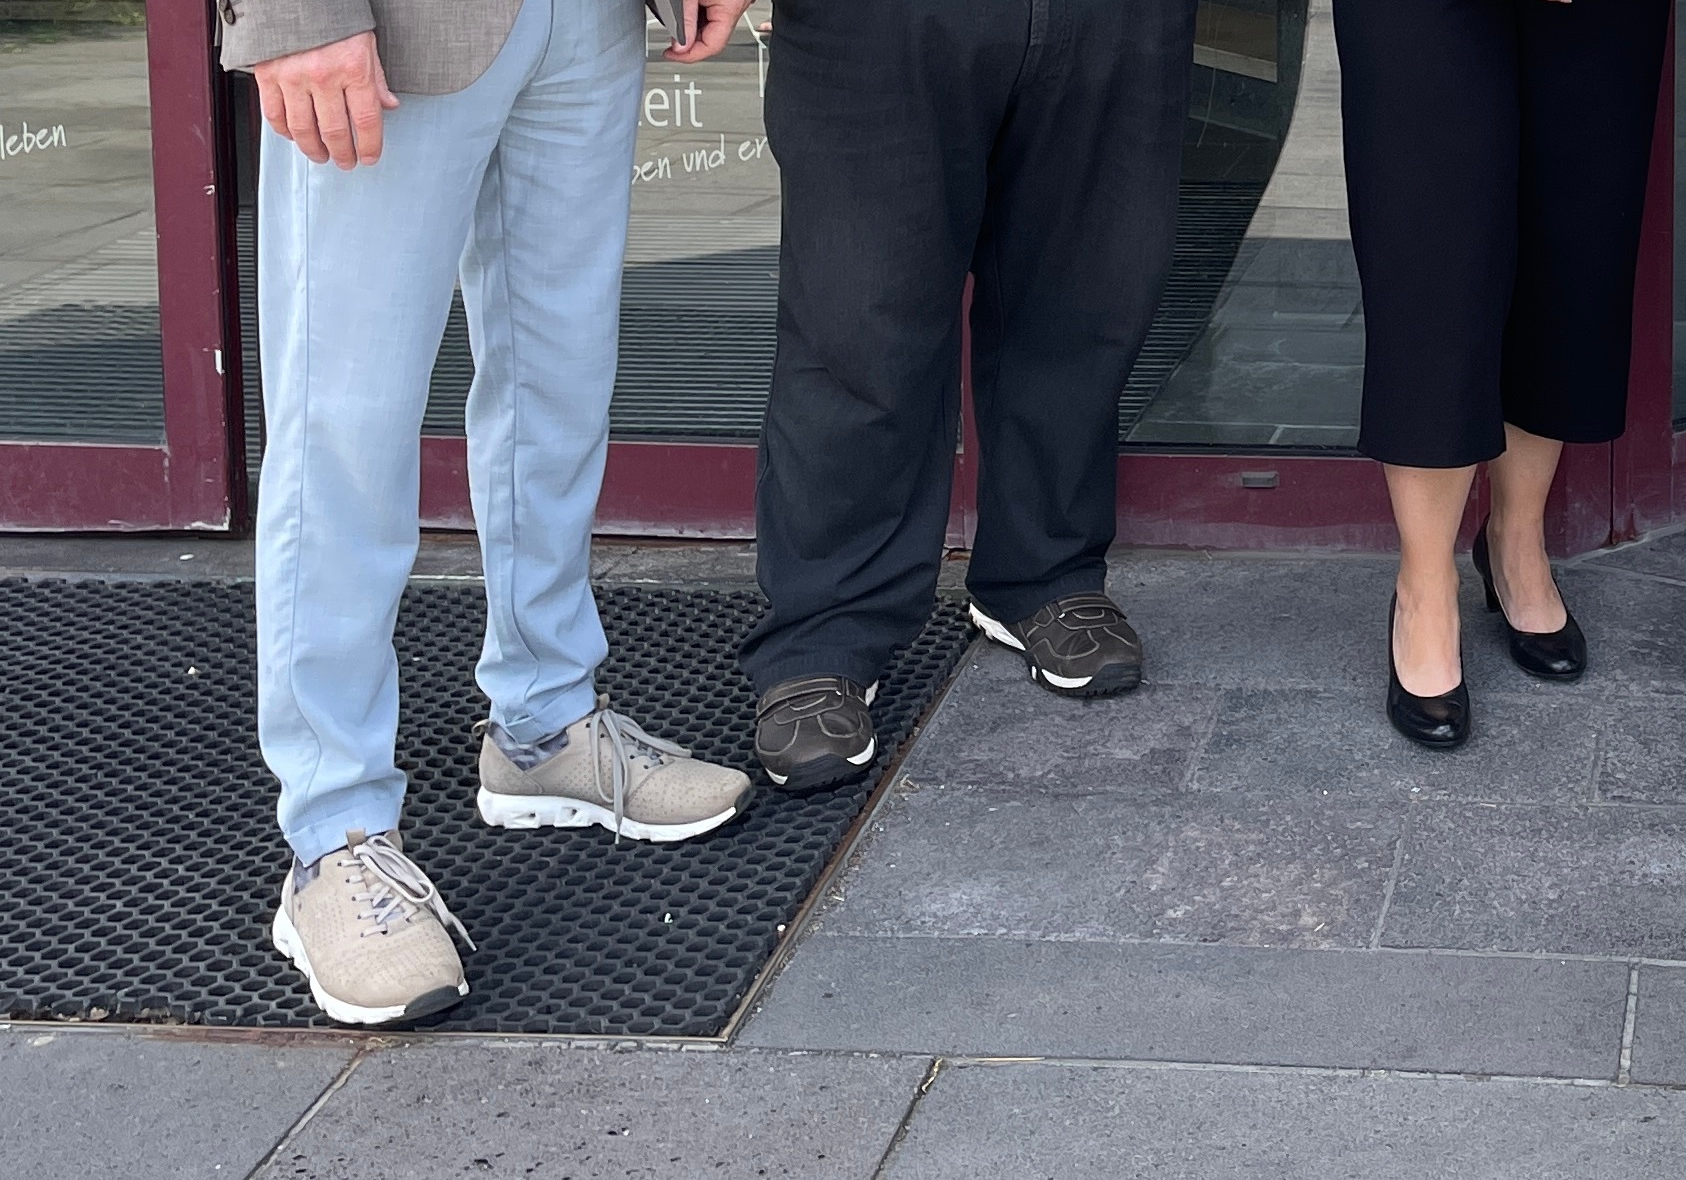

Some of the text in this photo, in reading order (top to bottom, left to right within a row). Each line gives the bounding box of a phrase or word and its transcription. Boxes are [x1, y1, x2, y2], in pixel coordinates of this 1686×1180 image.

[638, 74, 703, 128] eit
[0, 121, 67, 161] leben
[681, 133, 726, 173] und
